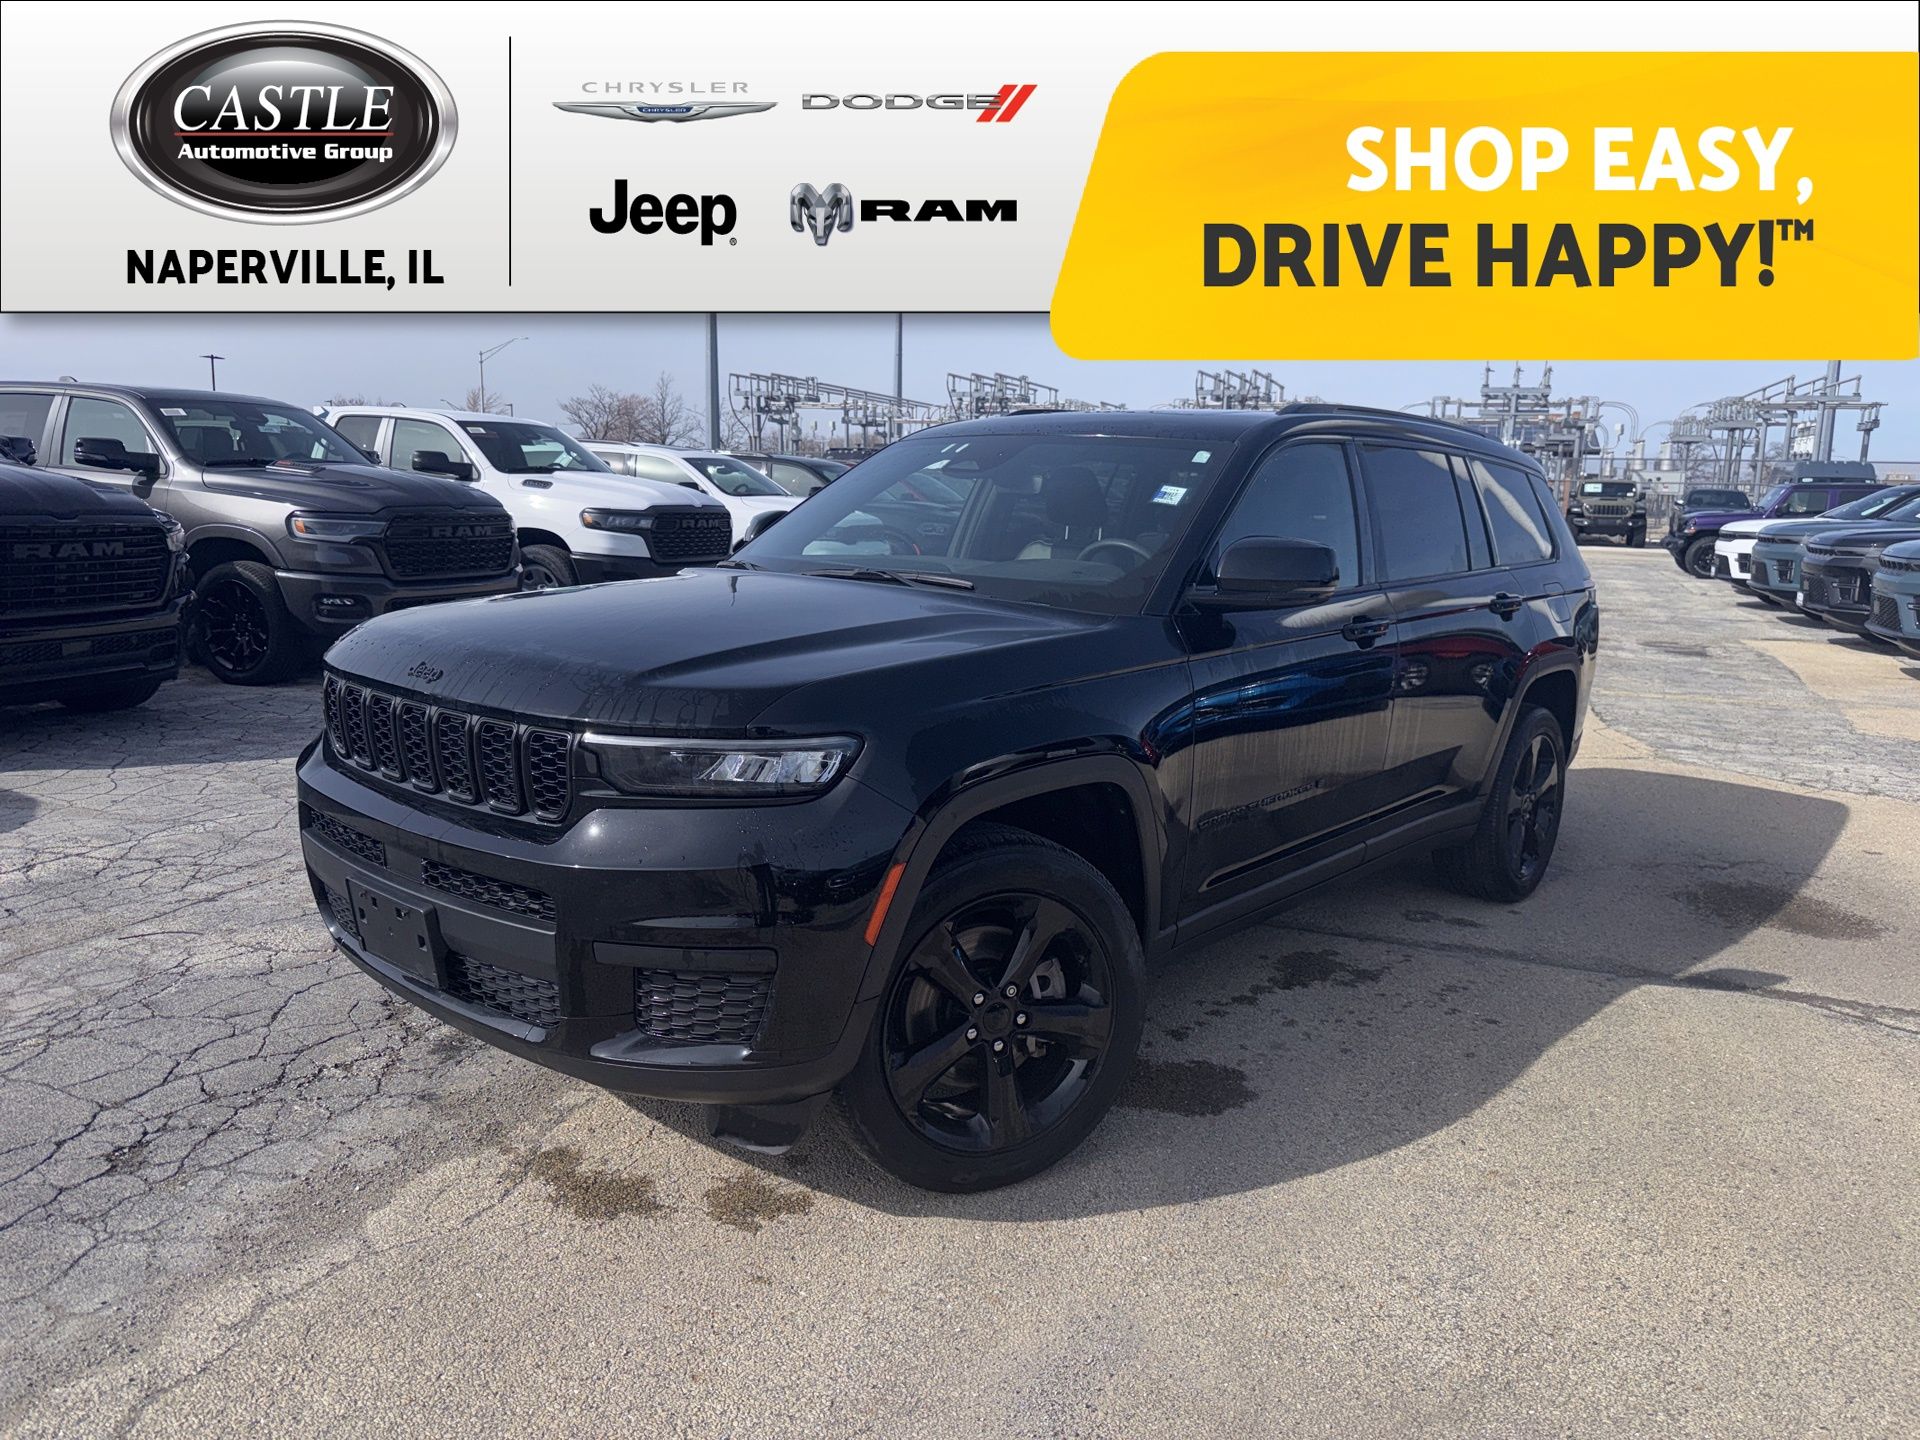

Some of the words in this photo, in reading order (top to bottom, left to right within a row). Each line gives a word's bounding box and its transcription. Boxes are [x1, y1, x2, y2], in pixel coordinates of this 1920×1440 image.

[682, 518, 719, 529] RAM
[431, 525, 492, 538] RAM
[13, 541, 124, 559] RAM
[408, 661, 444, 684] Jeep
